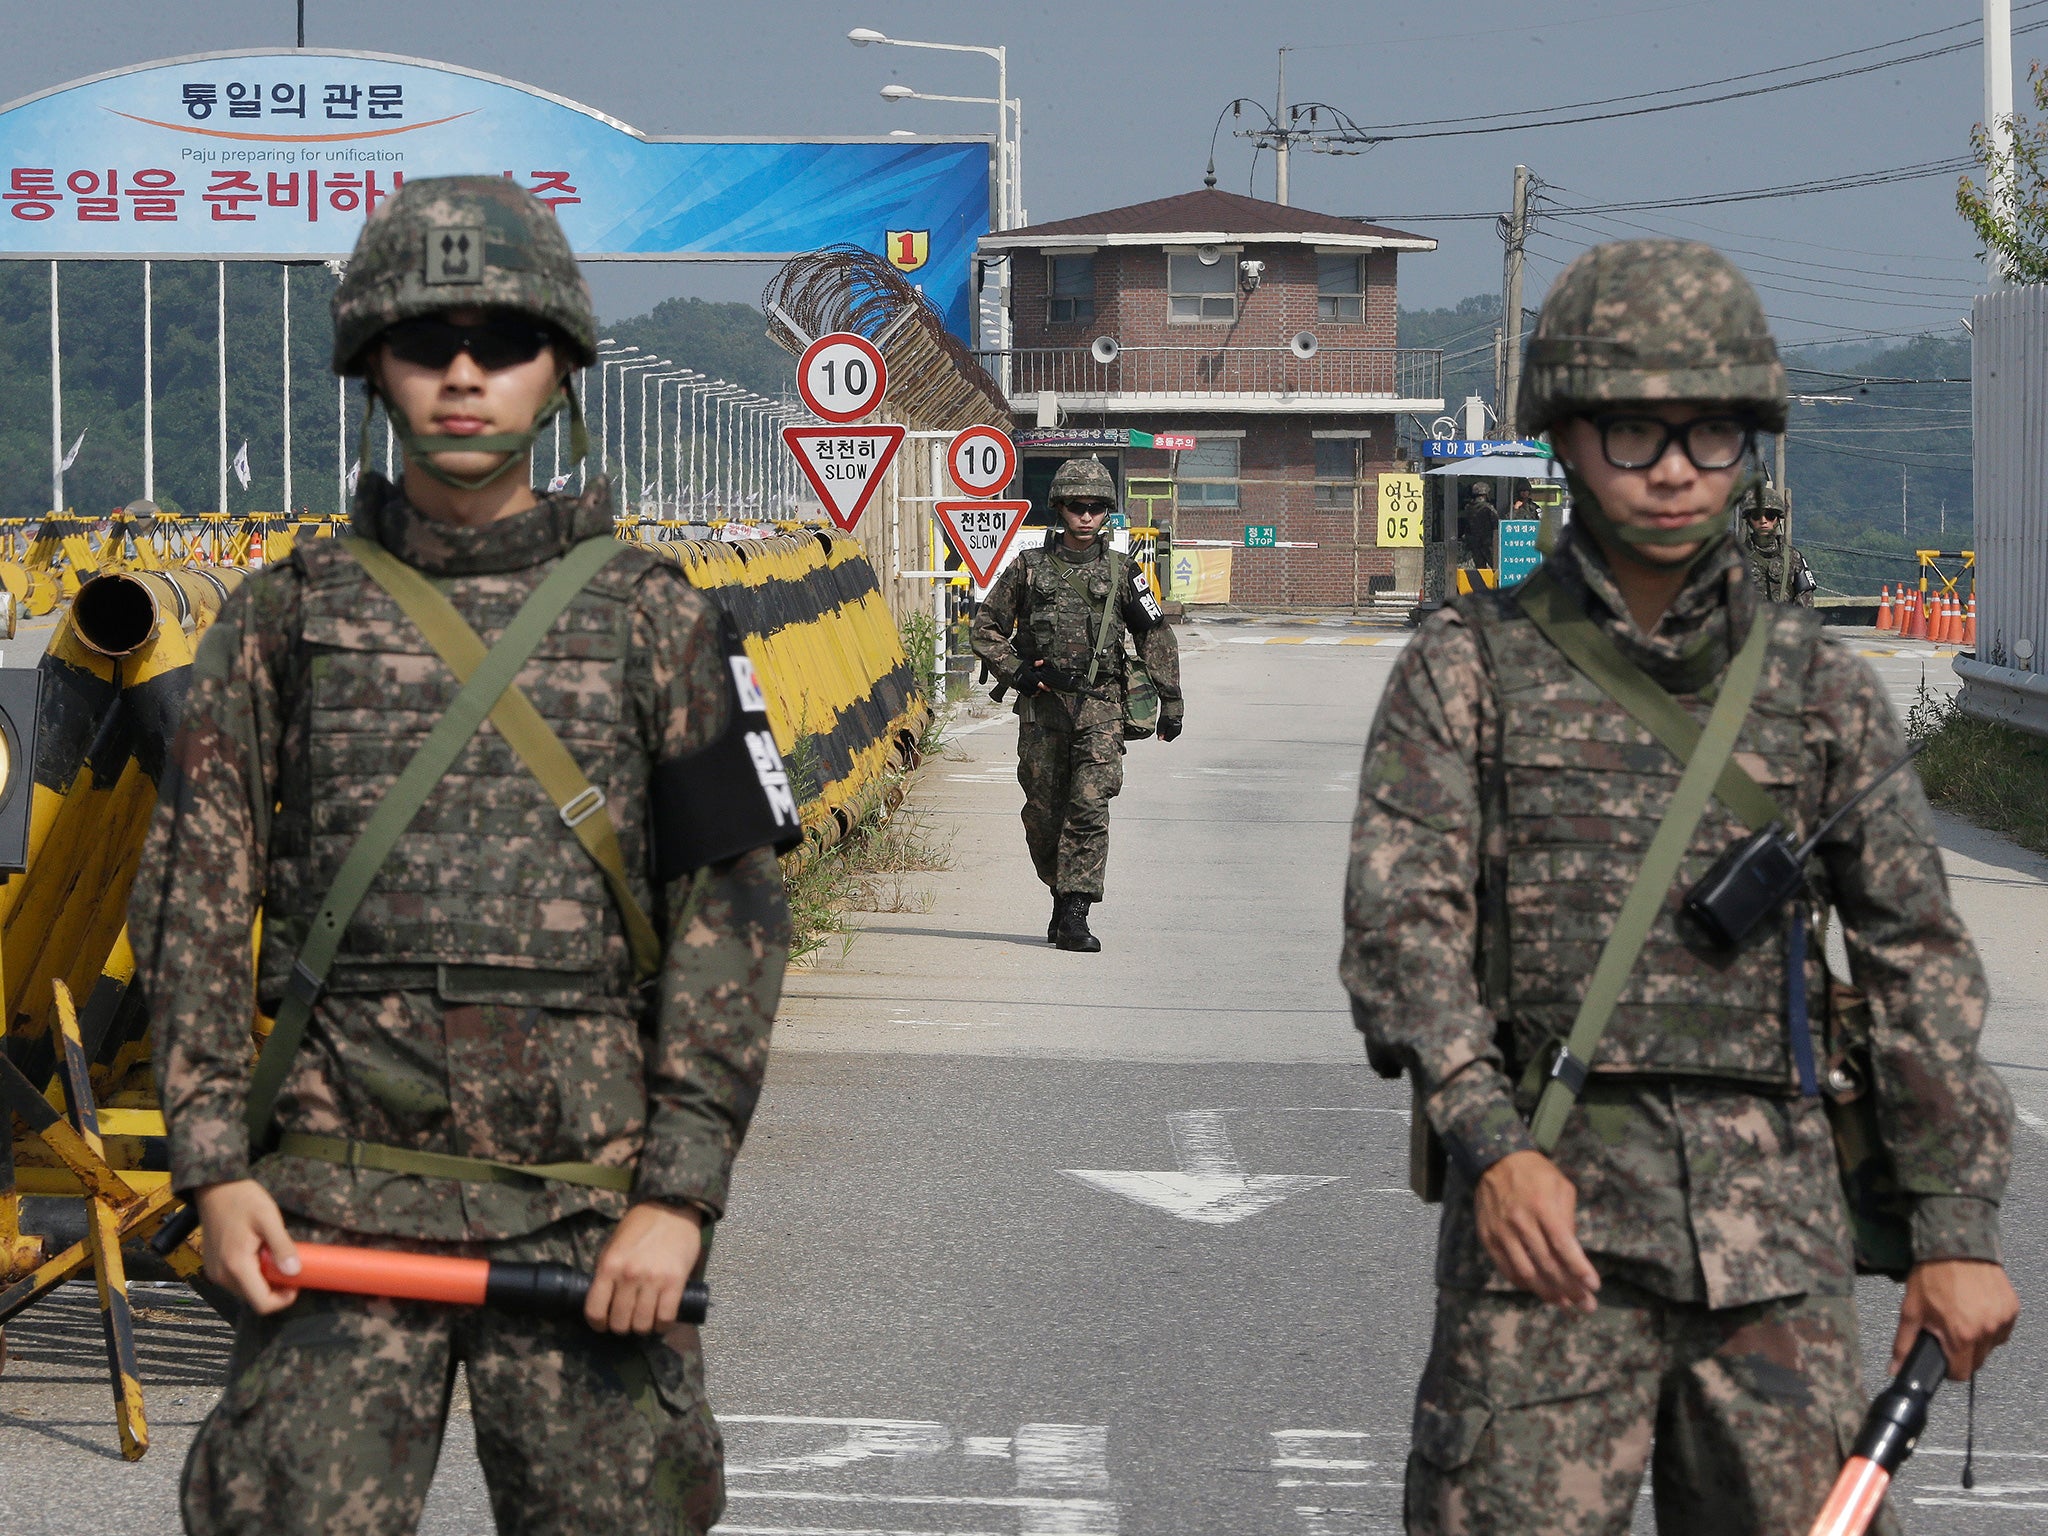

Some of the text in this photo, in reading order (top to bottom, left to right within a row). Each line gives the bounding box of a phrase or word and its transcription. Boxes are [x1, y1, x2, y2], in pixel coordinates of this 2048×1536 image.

[181, 83, 404, 120] 통일의 관문
[181, 147, 404, 162] Paju preparing for unification
[2, 168, 185, 222] 통일을
[897, 233, 917, 264] 1
[821, 359, 867, 396] 10
[815, 438, 876, 460] 천천히
[964, 445, 998, 475] 10
[825, 464, 868, 480] SLOW
[1385, 480, 1422, 513] 영농
[961, 511, 1007, 532] 천천히
[1248, 527, 1273, 538] 정지
[1386, 517, 1409, 539] 05
[969, 534, 998, 550] SLOW
[1248, 538, 1273, 546] STOP
